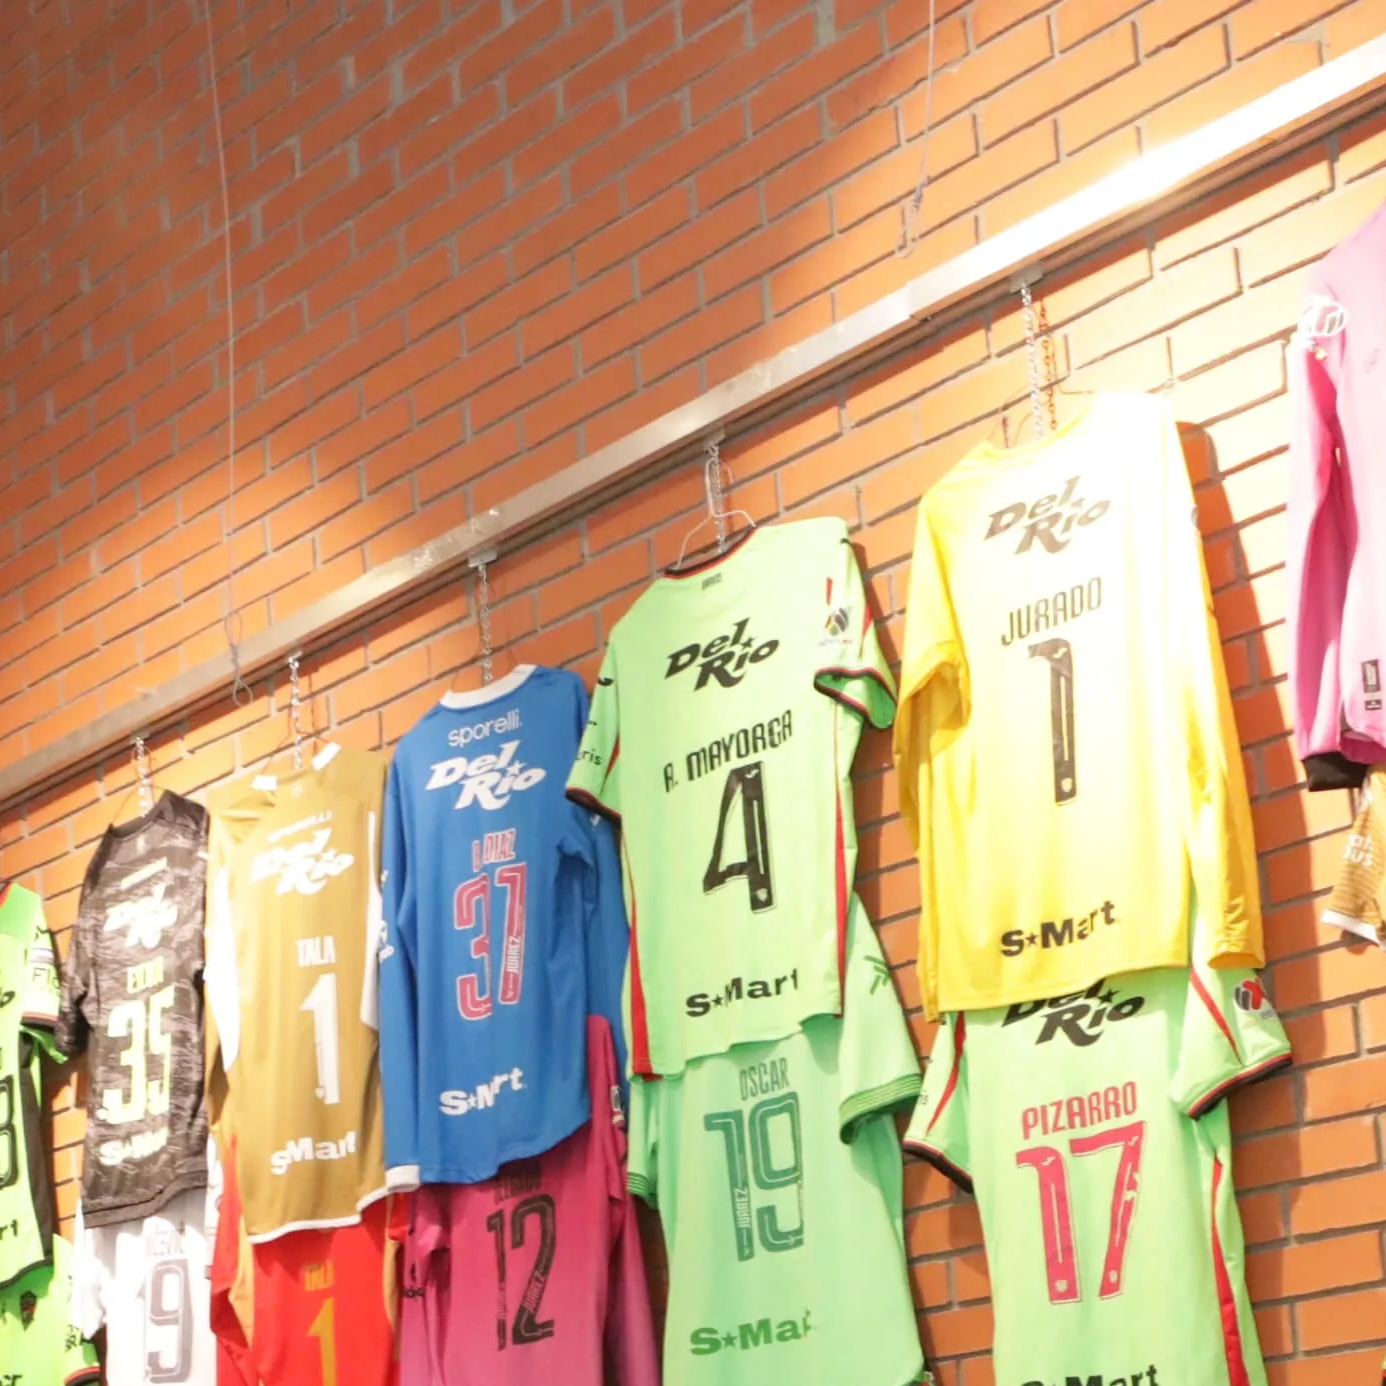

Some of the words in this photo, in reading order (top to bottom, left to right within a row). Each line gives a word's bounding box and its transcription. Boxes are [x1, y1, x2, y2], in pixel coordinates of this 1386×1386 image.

[982, 475, 1085, 541] Del
[1014, 498, 1113, 555] Rio
[1000, 575, 1104, 648] JURADO
[663, 617, 752, 681] Del
[693, 638, 781, 692] Rio
[447, 709, 524, 748] sporelli
[686, 709, 794, 785] MAYORGA
[1027, 636, 1078, 807] 1
[424, 739, 525, 792] Del
[453, 760, 547, 812] Rio
[703, 760, 776, 915] 4
[453, 862, 528, 1022] 37
[96, 985, 175, 1125] 35
[298, 973, 340, 1104] 1
[1034, 995, 1146, 1048] Rio
[739, 1056, 790, 1102] OSCAR
[1021, 1080, 1139, 1141] PIZARRO
[703, 1091, 805, 1263] 19
[1015, 1120, 1146, 1305] 17
[485, 1192, 557, 1352] 12
[144, 1258, 194, 1384] 9
